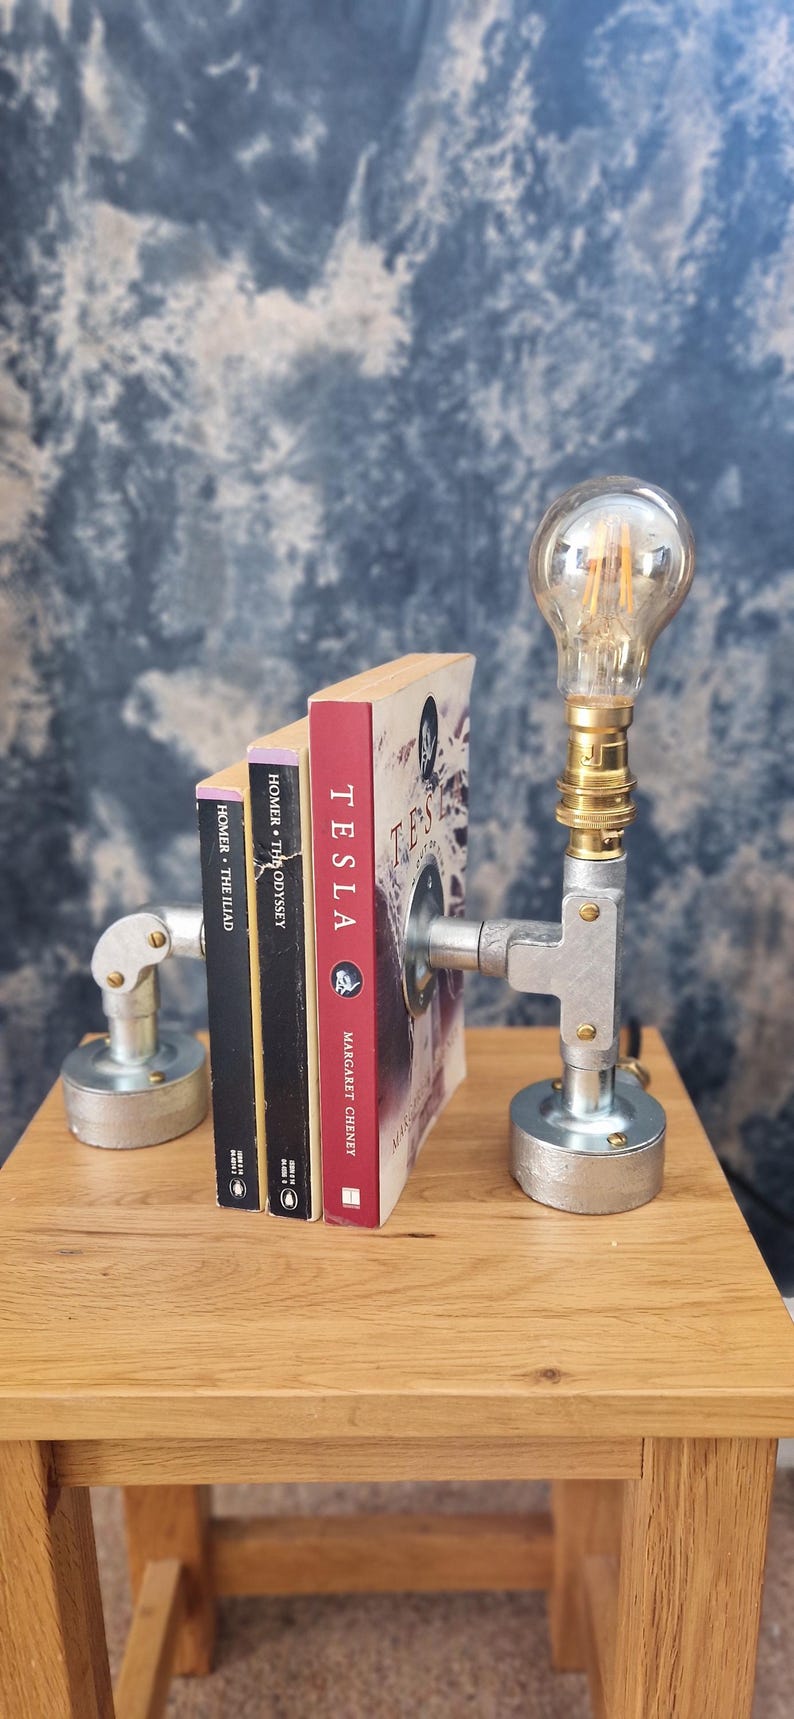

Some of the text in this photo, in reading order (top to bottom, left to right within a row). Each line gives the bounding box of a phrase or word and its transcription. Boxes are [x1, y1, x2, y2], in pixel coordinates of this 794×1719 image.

[268, 774, 281, 826] HOMER
[330, 784, 357, 931] TESLA
[217, 804, 234, 932] HOMER THE ILIAD
[273, 870, 286, 929] ODYSSEY
[343, 1032, 356, 1157] MARGARET CHENEY
